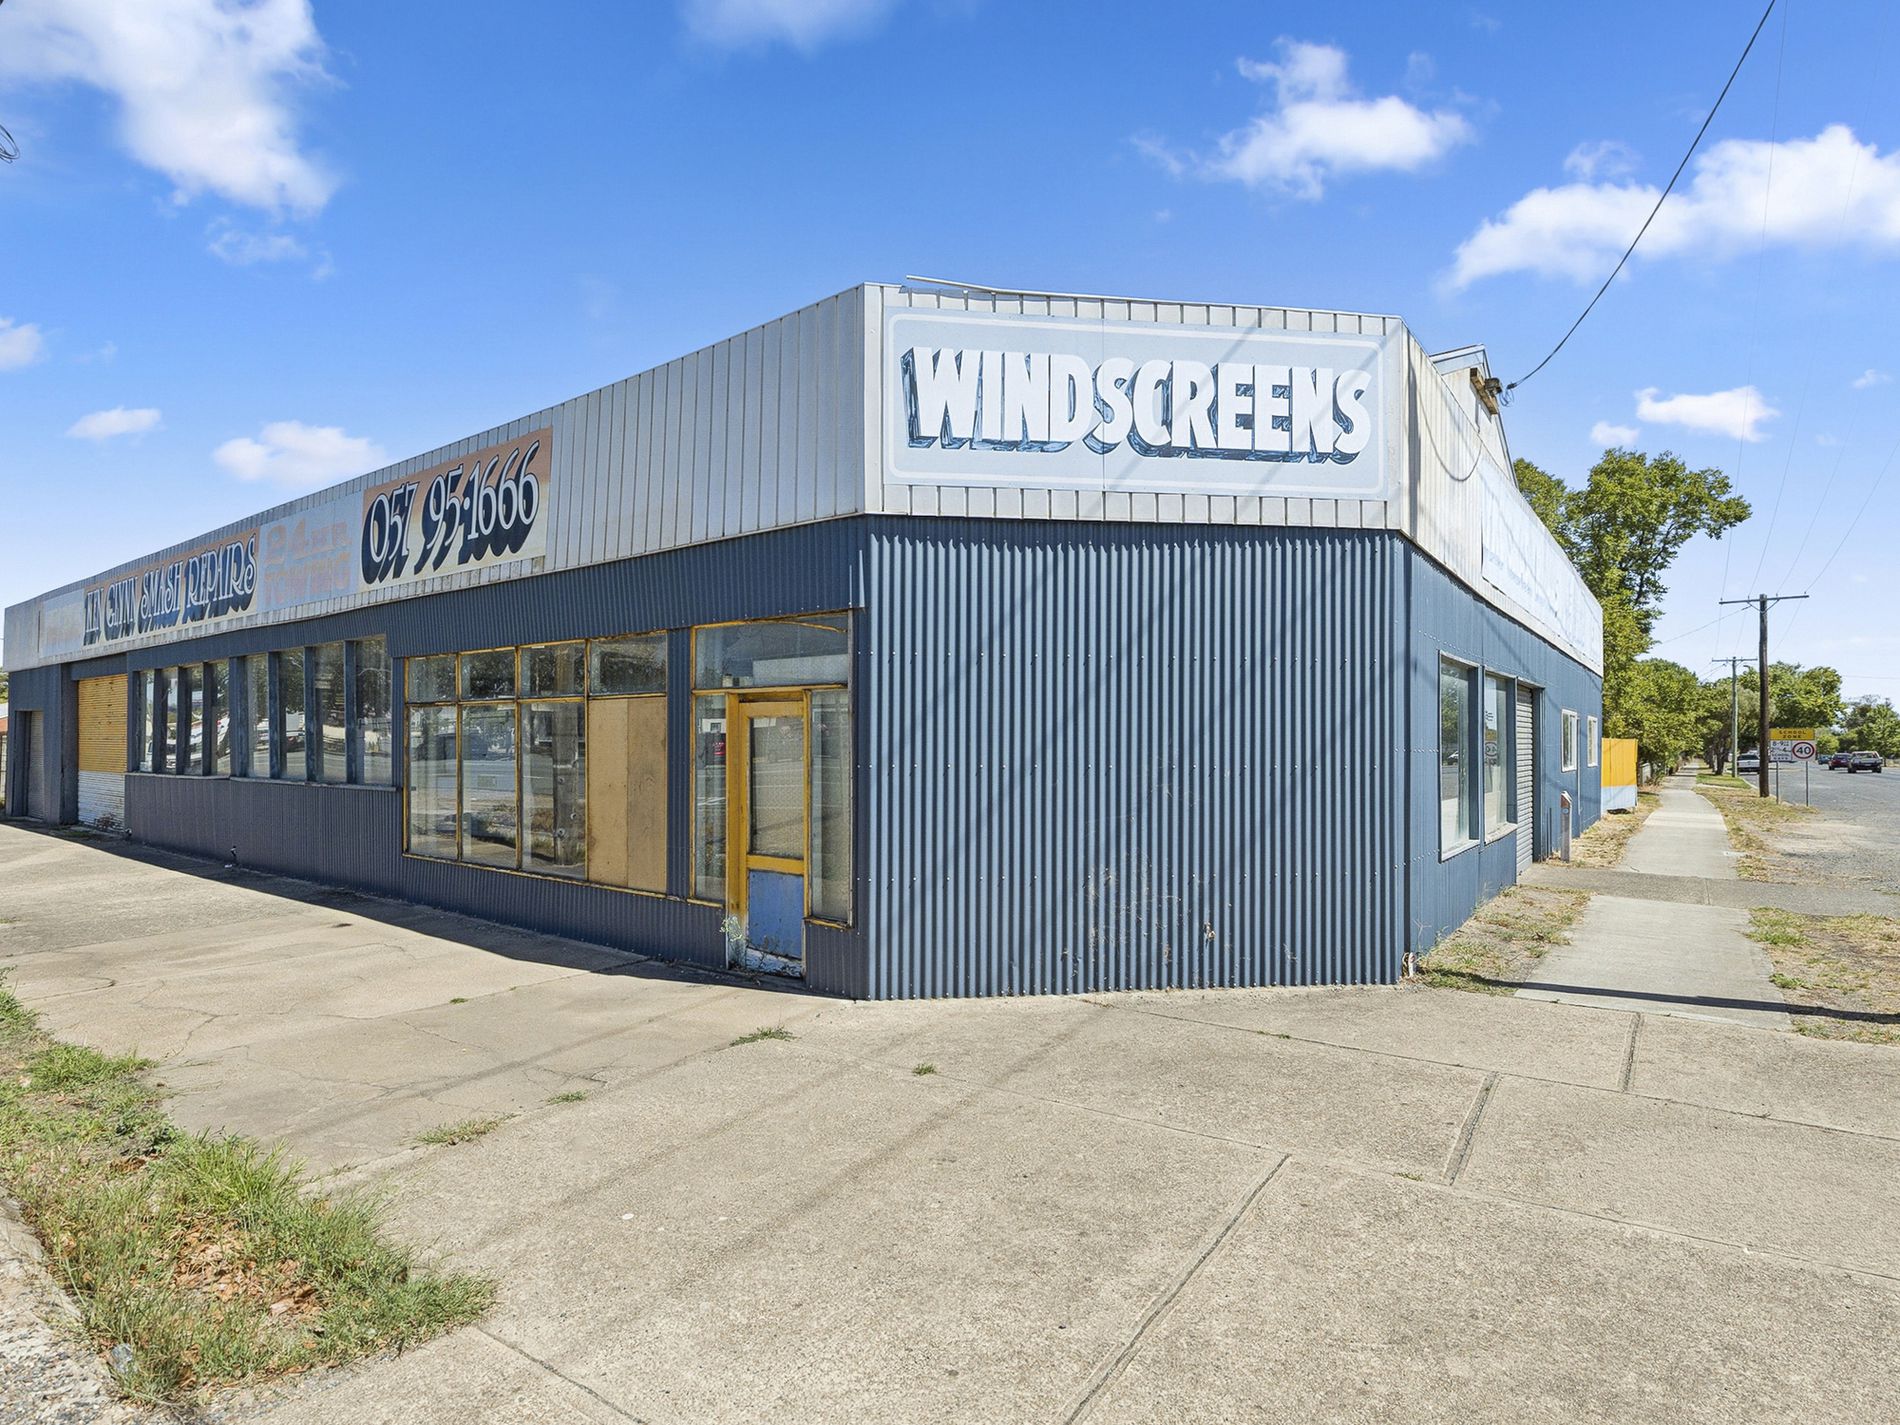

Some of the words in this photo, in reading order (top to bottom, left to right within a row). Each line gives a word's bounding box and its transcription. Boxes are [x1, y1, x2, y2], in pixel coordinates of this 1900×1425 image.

[901, 346, 1373, 465] WINDSCREENS
[363, 481, 420, 580] 057
[104, 575, 138, 639] GLYNN
[138, 560, 183, 630] SMASH
[183, 532, 257, 622] REPAIRS
[1796, 746, 1811, 755] 40
